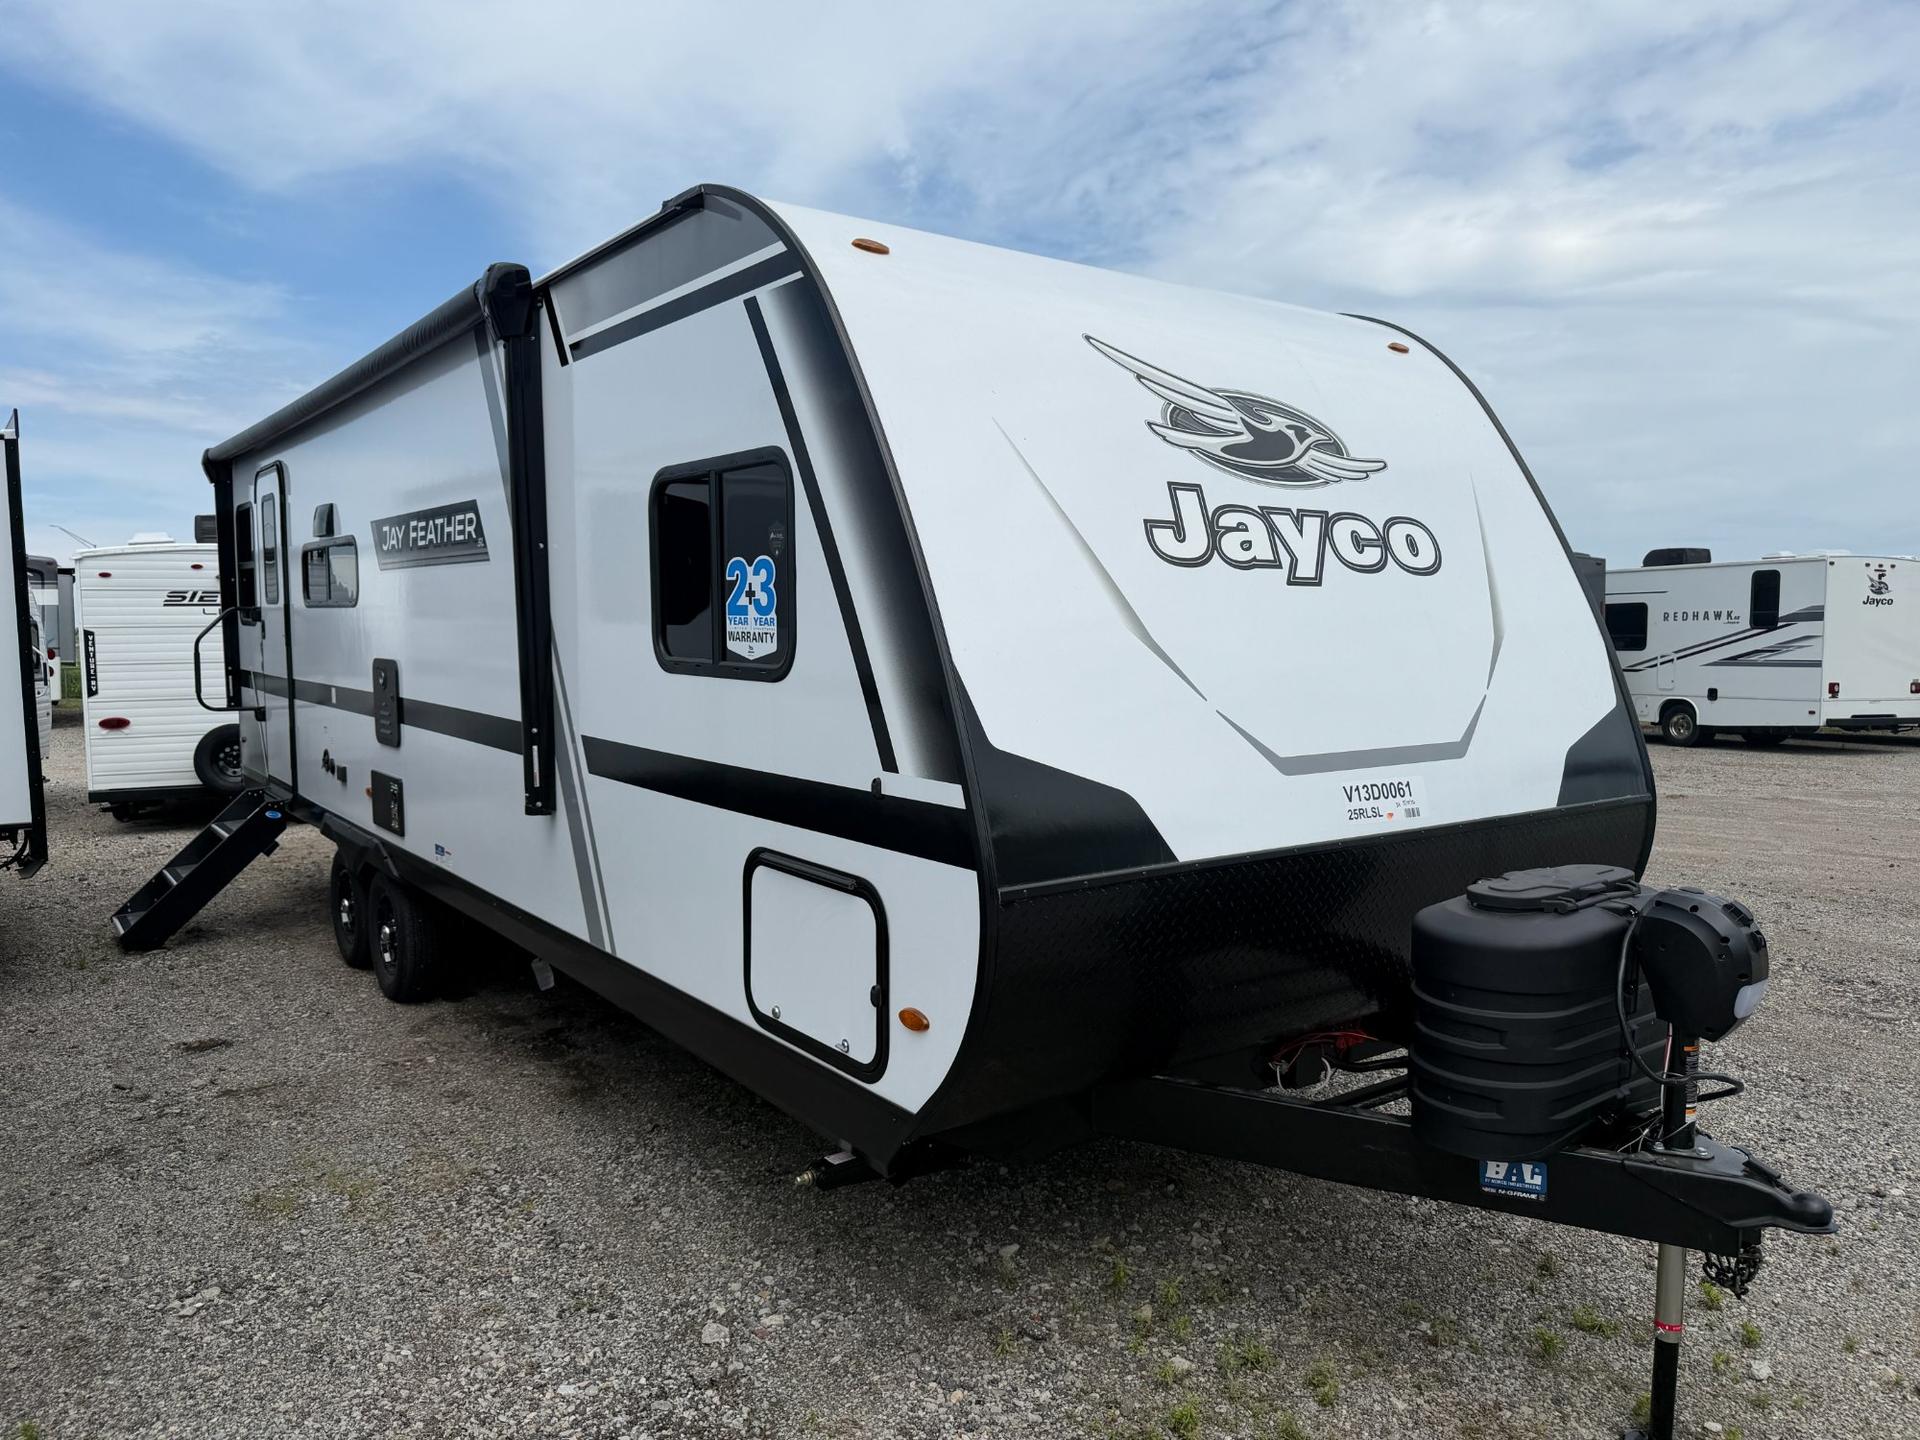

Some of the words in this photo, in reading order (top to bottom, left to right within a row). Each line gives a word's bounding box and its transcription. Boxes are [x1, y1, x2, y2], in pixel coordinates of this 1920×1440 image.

[382, 526, 405, 551] JAY
[409, 513, 477, 548] FEATHER
[1143, 481, 1442, 587] Jayco
[163, 590, 221, 603] SIE
[1862, 595, 1894, 607] Jayco
[728, 616, 749, 626] YEAR
[753, 616, 775, 627] YEAR
[1663, 609, 1734, 621] REDHAWK
[727, 630, 775, 644] WARRANTY
[1342, 780, 1412, 803] V13D0061
[1347, 806, 1384, 820] 25RLSL
